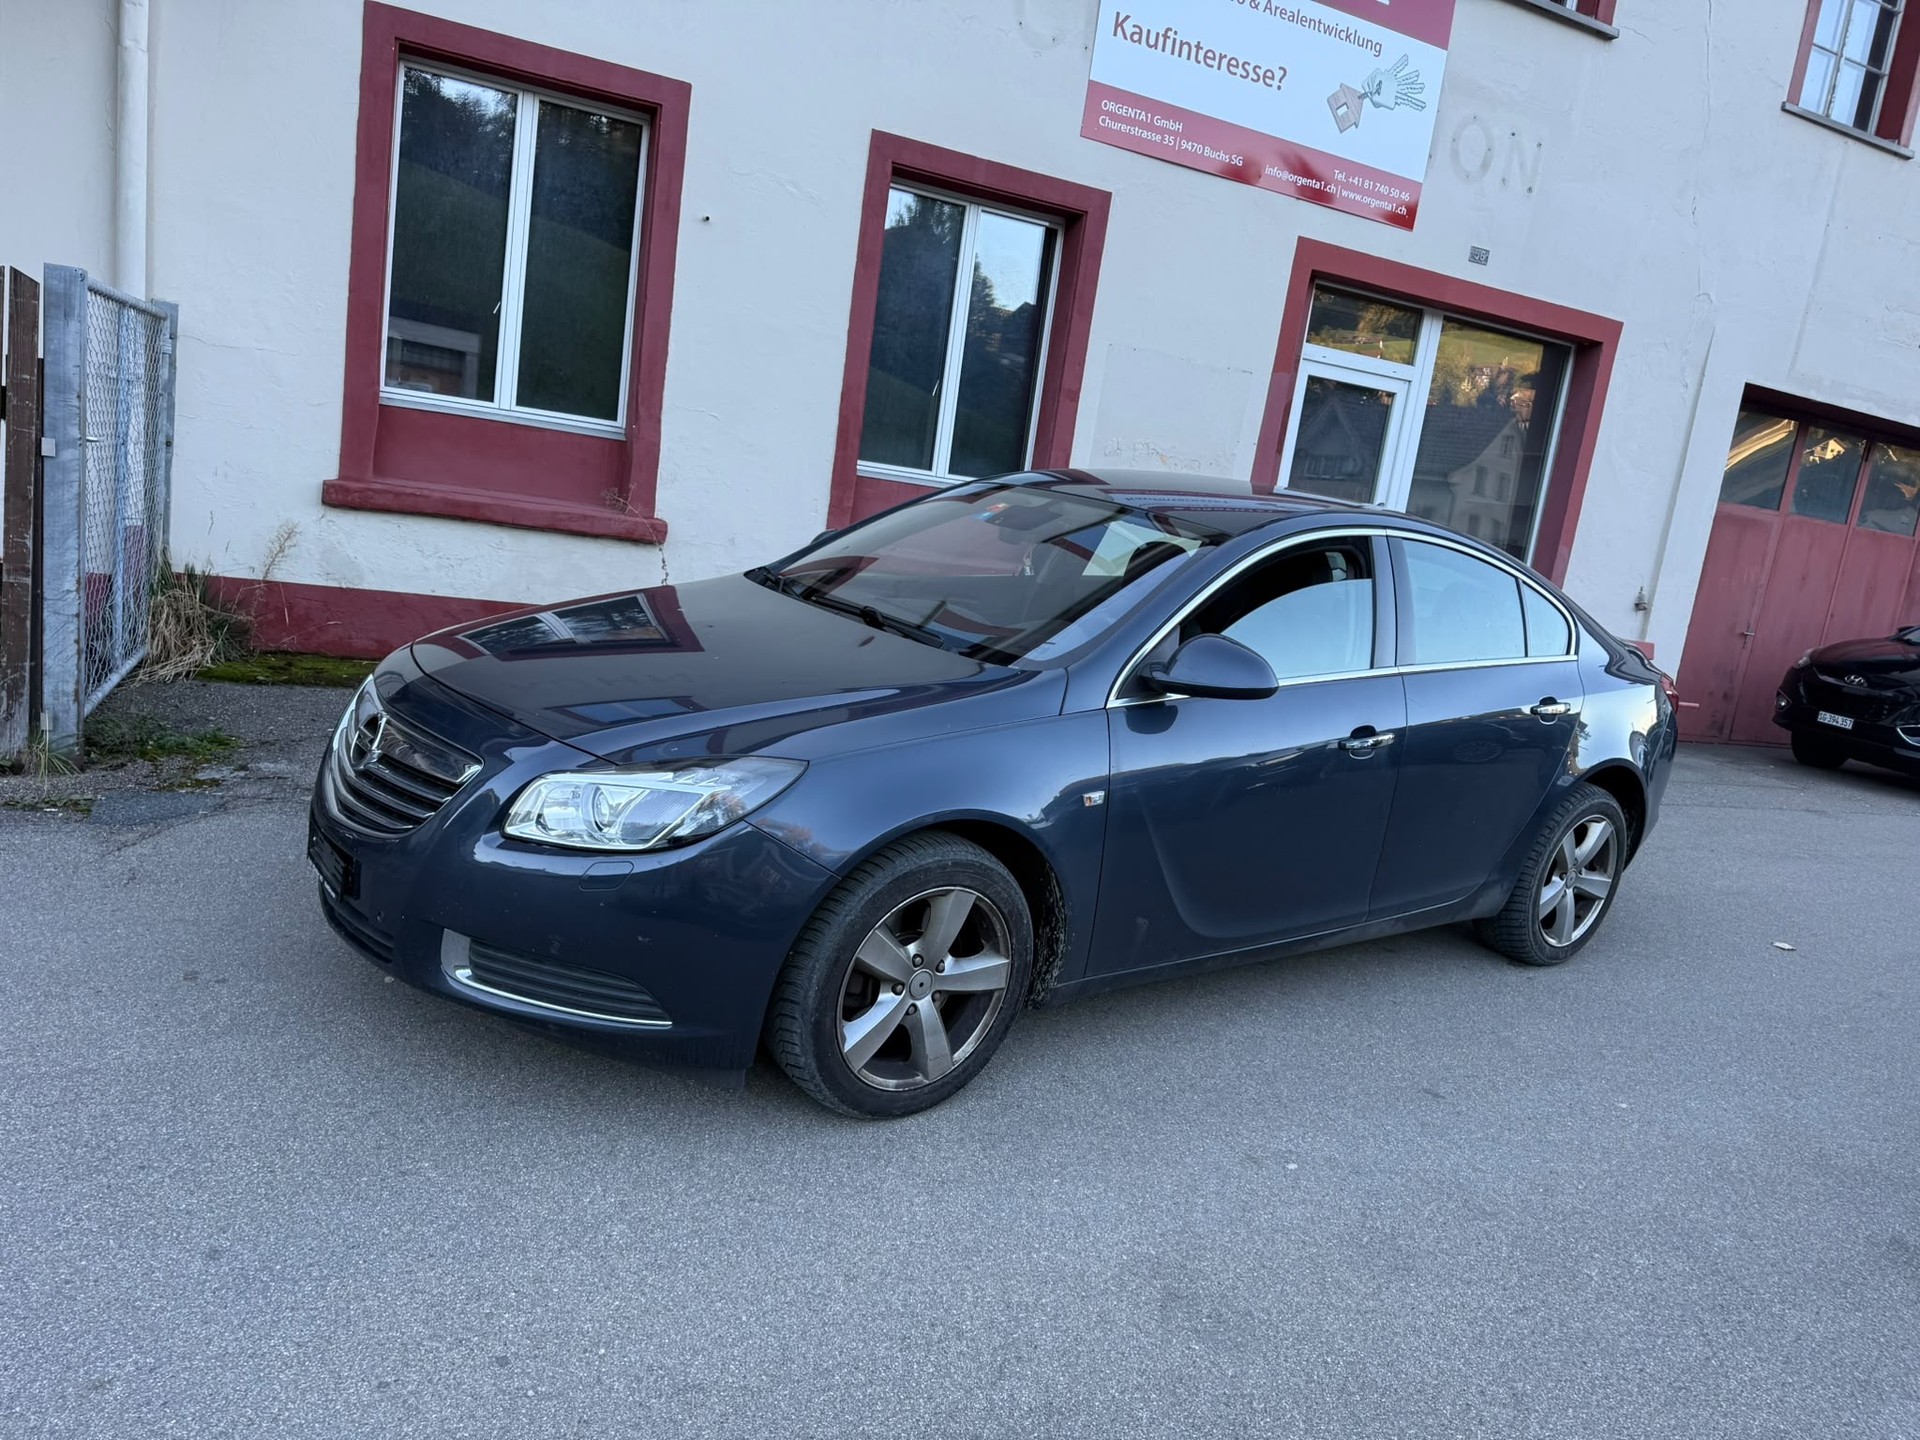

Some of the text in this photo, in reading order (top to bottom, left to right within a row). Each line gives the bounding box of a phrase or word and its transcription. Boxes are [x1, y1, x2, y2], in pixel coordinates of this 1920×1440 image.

[1112, 11, 1287, 91] Kaufinteresse?
[1262, 0, 1383, 57] Arealentwicklung
[1098, 115, 1162, 143] Churerstrasse
[1163, 134, 1175, 146] 35
[1180, 139, 1203, 155] 9470
[1204, 146, 1230, 163] Buchs
[1230, 154, 1243, 167] SG
[1101, 99, 1183, 133] ORGENTA1 GmbH
[1264, 164, 1337, 194] info@orgenta1.ch
[1341, 188, 1408, 216] www.orgenta1.ch
[1333, 169, 1410, 202] Tel. +41 81 740 50 46
